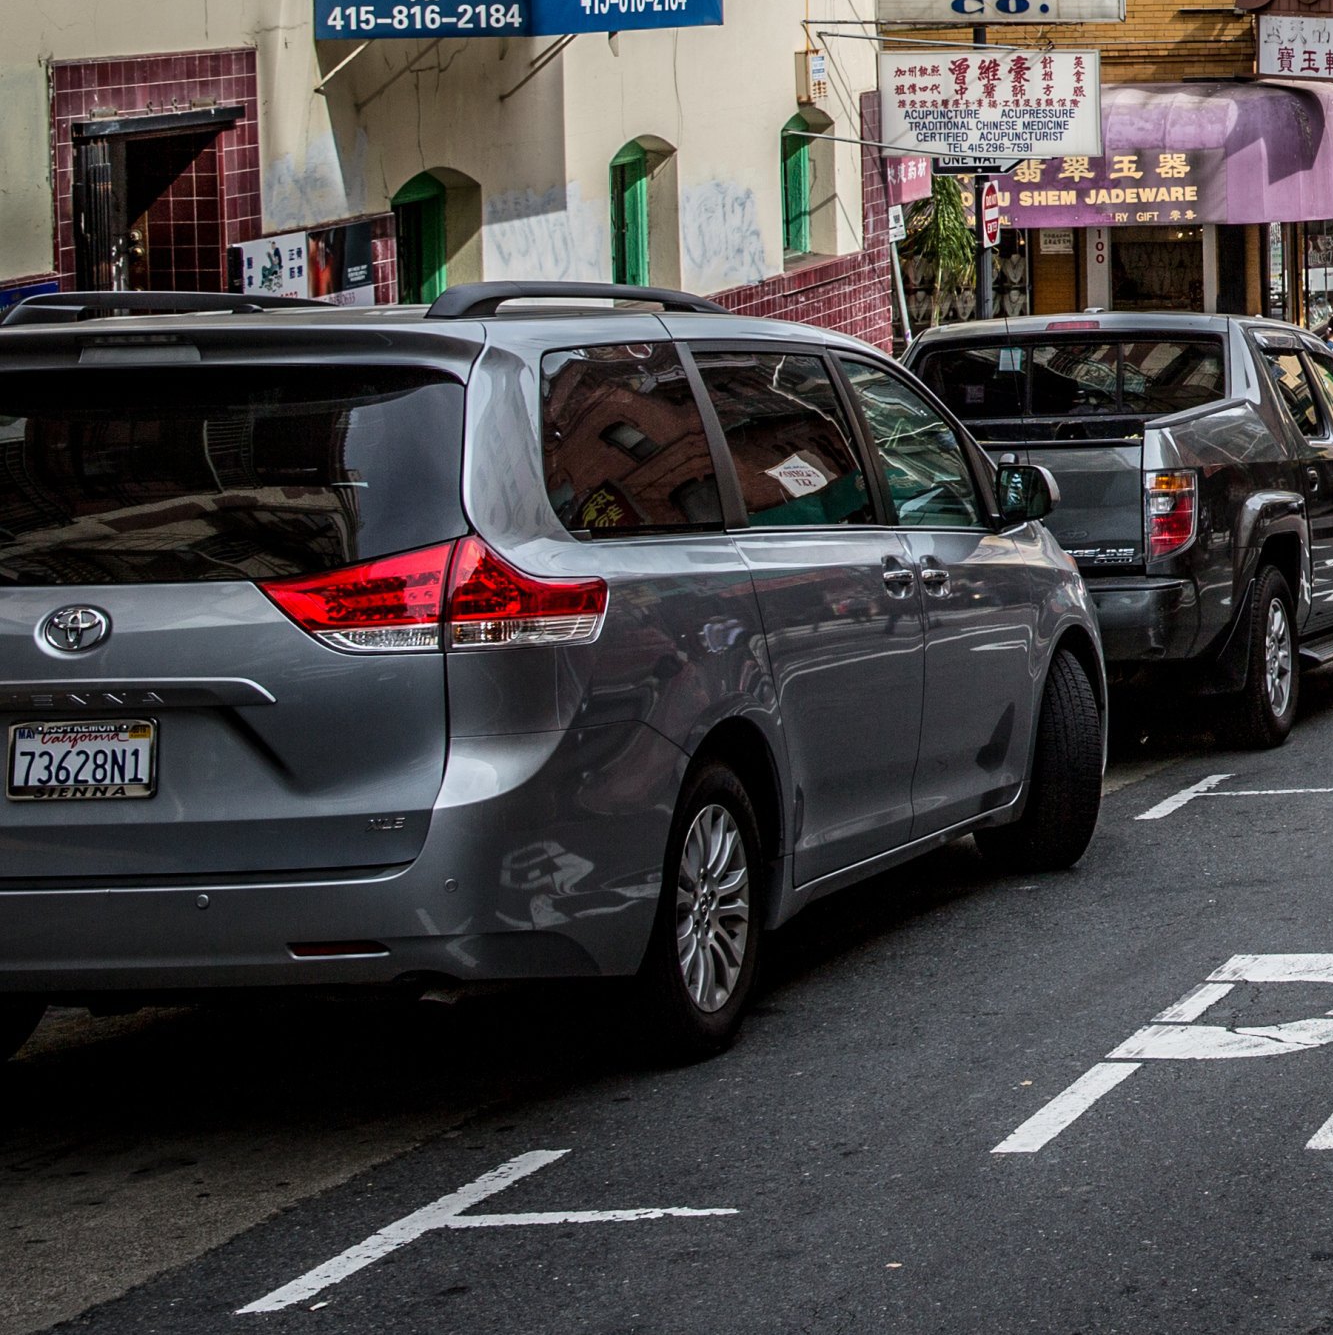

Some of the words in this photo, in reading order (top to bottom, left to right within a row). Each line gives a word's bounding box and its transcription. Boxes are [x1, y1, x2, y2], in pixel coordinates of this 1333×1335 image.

[327, 4, 522, 30] 415-816-2184
[904, 109, 980, 119] ACUPUNCTURE
[1001, 108, 1075, 119] ACUPRESSURE
[908, 121, 972, 130] TRADITIONAL
[976, 121, 1017, 130] CHINESE
[1022, 120, 1069, 130] MEDICINE
[916, 132, 968, 142] CERTIFIED
[979, 131, 1064, 141] ACUPUNCTURIST
[1019, 190, 1076, 206] SHEM
[1084, 186, 1197, 205] JADEWARE
[1136, 212, 1159, 221] GIFT
[41, 732, 129, 749] California
[20, 748, 144, 786] 73628N1
[33, 786, 126, 798] SIENNA
